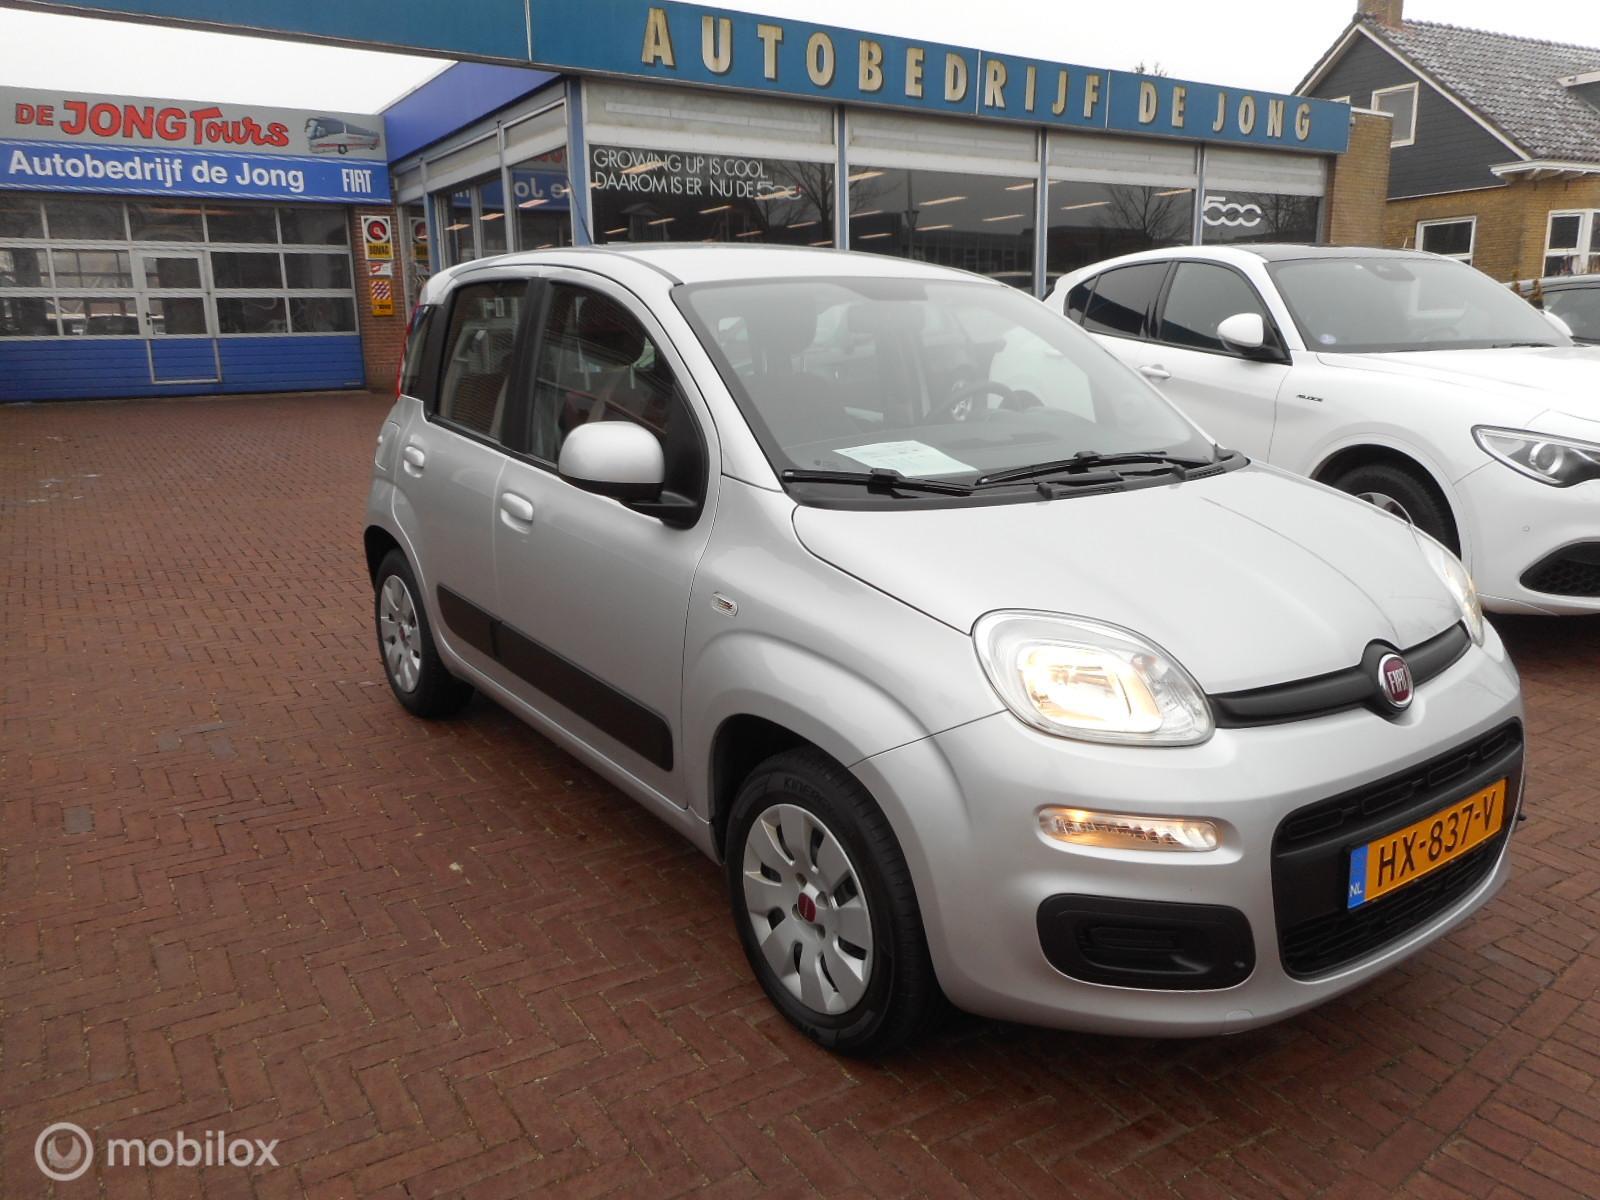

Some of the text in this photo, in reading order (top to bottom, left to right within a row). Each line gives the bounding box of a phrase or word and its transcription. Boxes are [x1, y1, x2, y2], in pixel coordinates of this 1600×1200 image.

[641, 7, 1311, 141] AUTOBEDRIJF DE JONG
[15, 100, 290, 147] DE JONG Tours
[8, 150, 305, 193] Autobedrijf de Jong
[593, 148, 769, 179] GROWING UP IS COOL
[341, 168, 372, 193] FIAT
[594, 171, 667, 194] DAAROM
[670, 176, 683, 195] IS
[686, 178, 703, 196] ER
[709, 180, 733, 198] NU
[736, 181, 754, 198] DE
[1203, 195, 1262, 228] 500
[1386, 665, 1407, 696] FIAT
[1376, 789, 1497, 888] HX-837-V
[1349, 884, 1364, 898] NL
